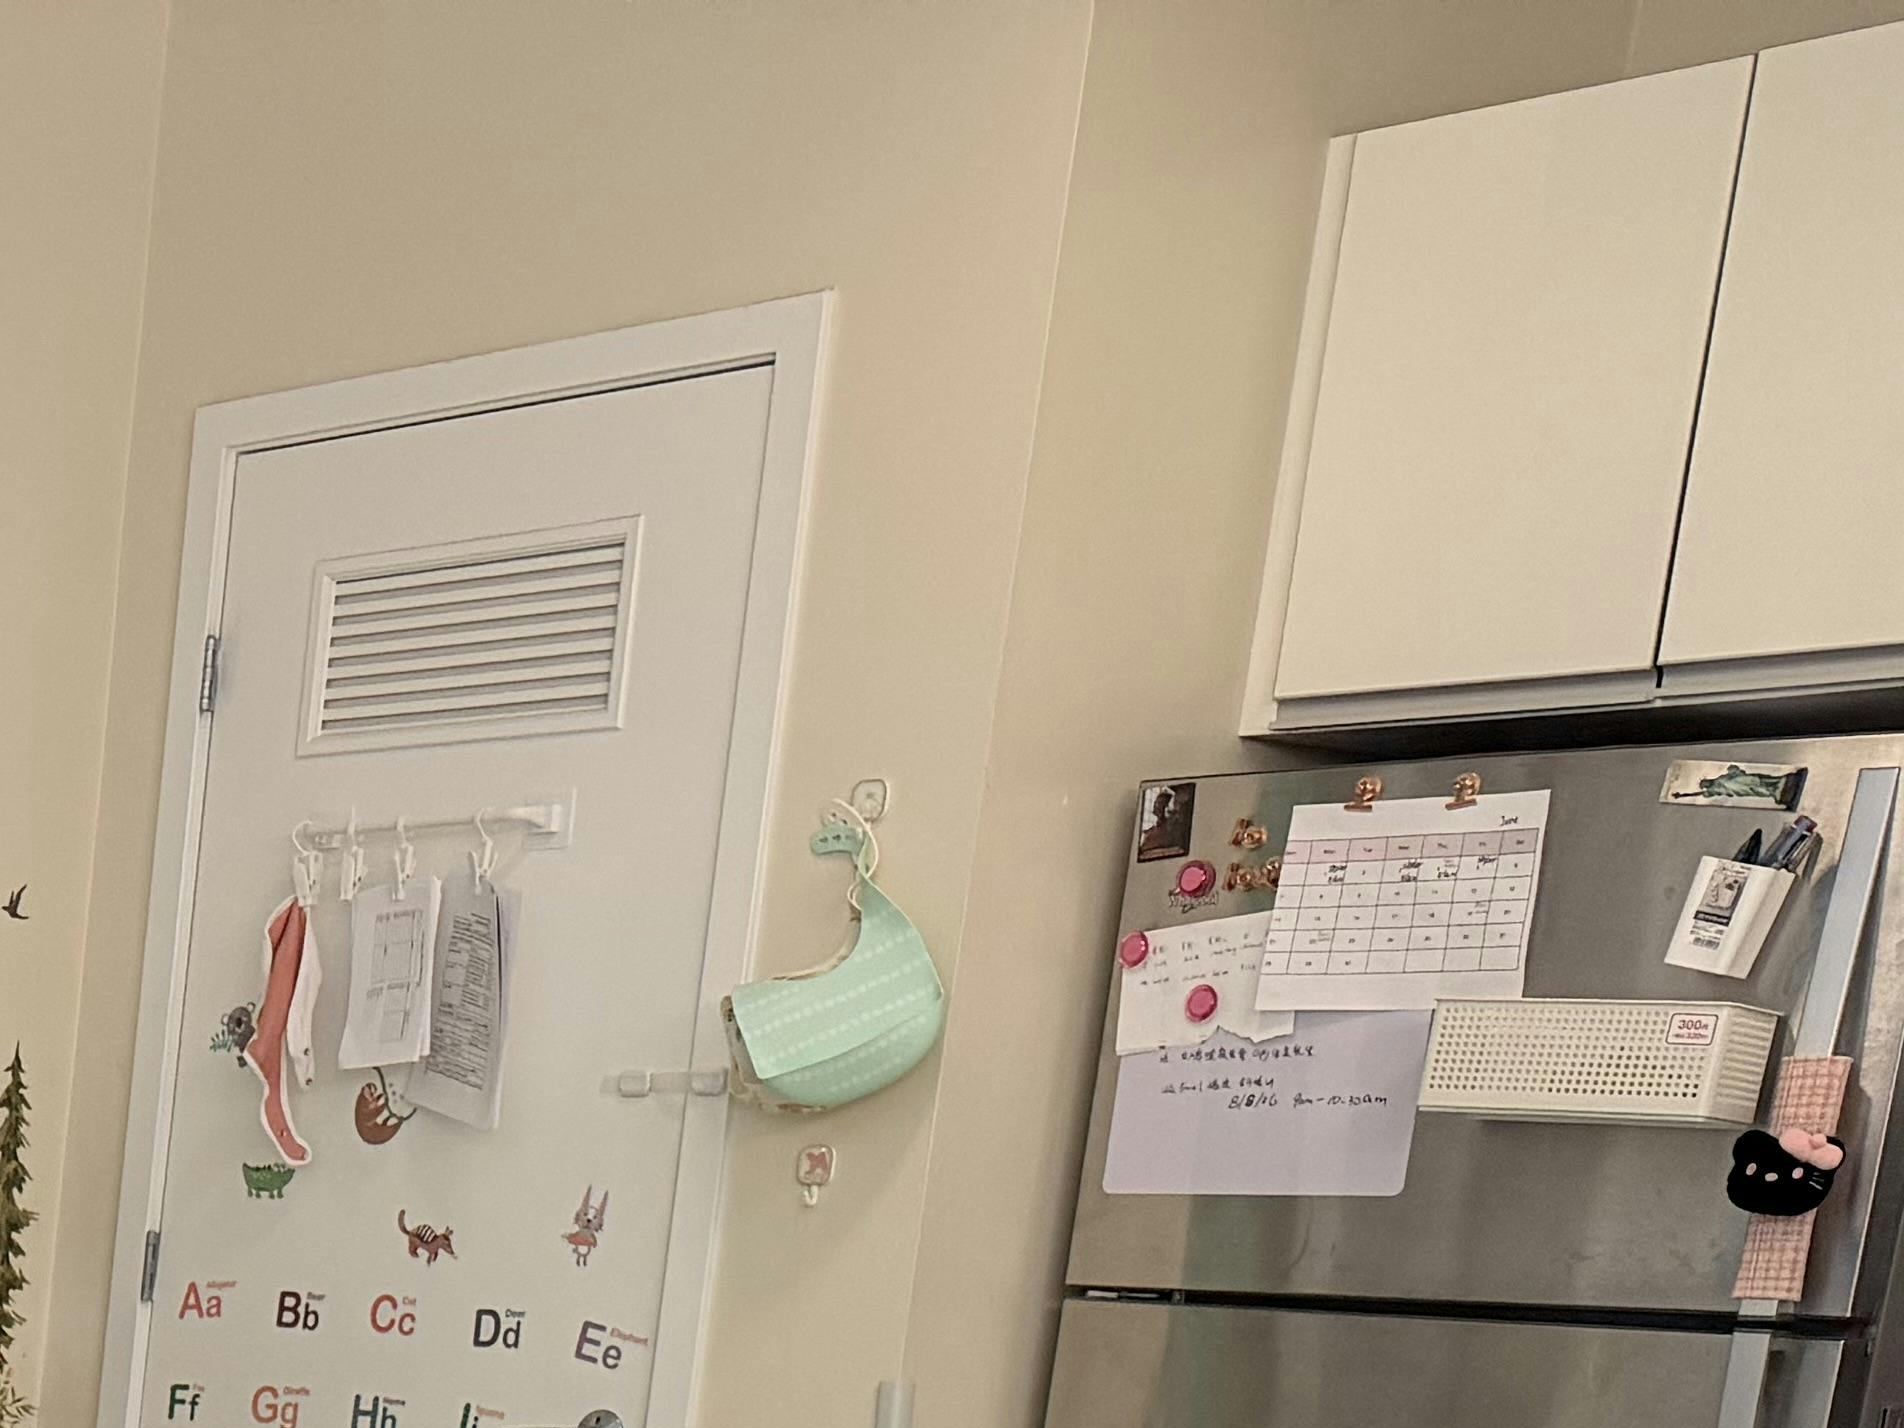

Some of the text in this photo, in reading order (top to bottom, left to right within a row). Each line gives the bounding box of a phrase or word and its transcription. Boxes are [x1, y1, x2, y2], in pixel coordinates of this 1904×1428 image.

[178, 1281, 223, 1320] Aa
[276, 1290, 320, 1331] Bb
[370, 1294, 417, 1336] Cc
[473, 1309, 522, 1350] Dd
[574, 1320, 623, 1370] Ee
[168, 1384, 201, 1421] Ff
